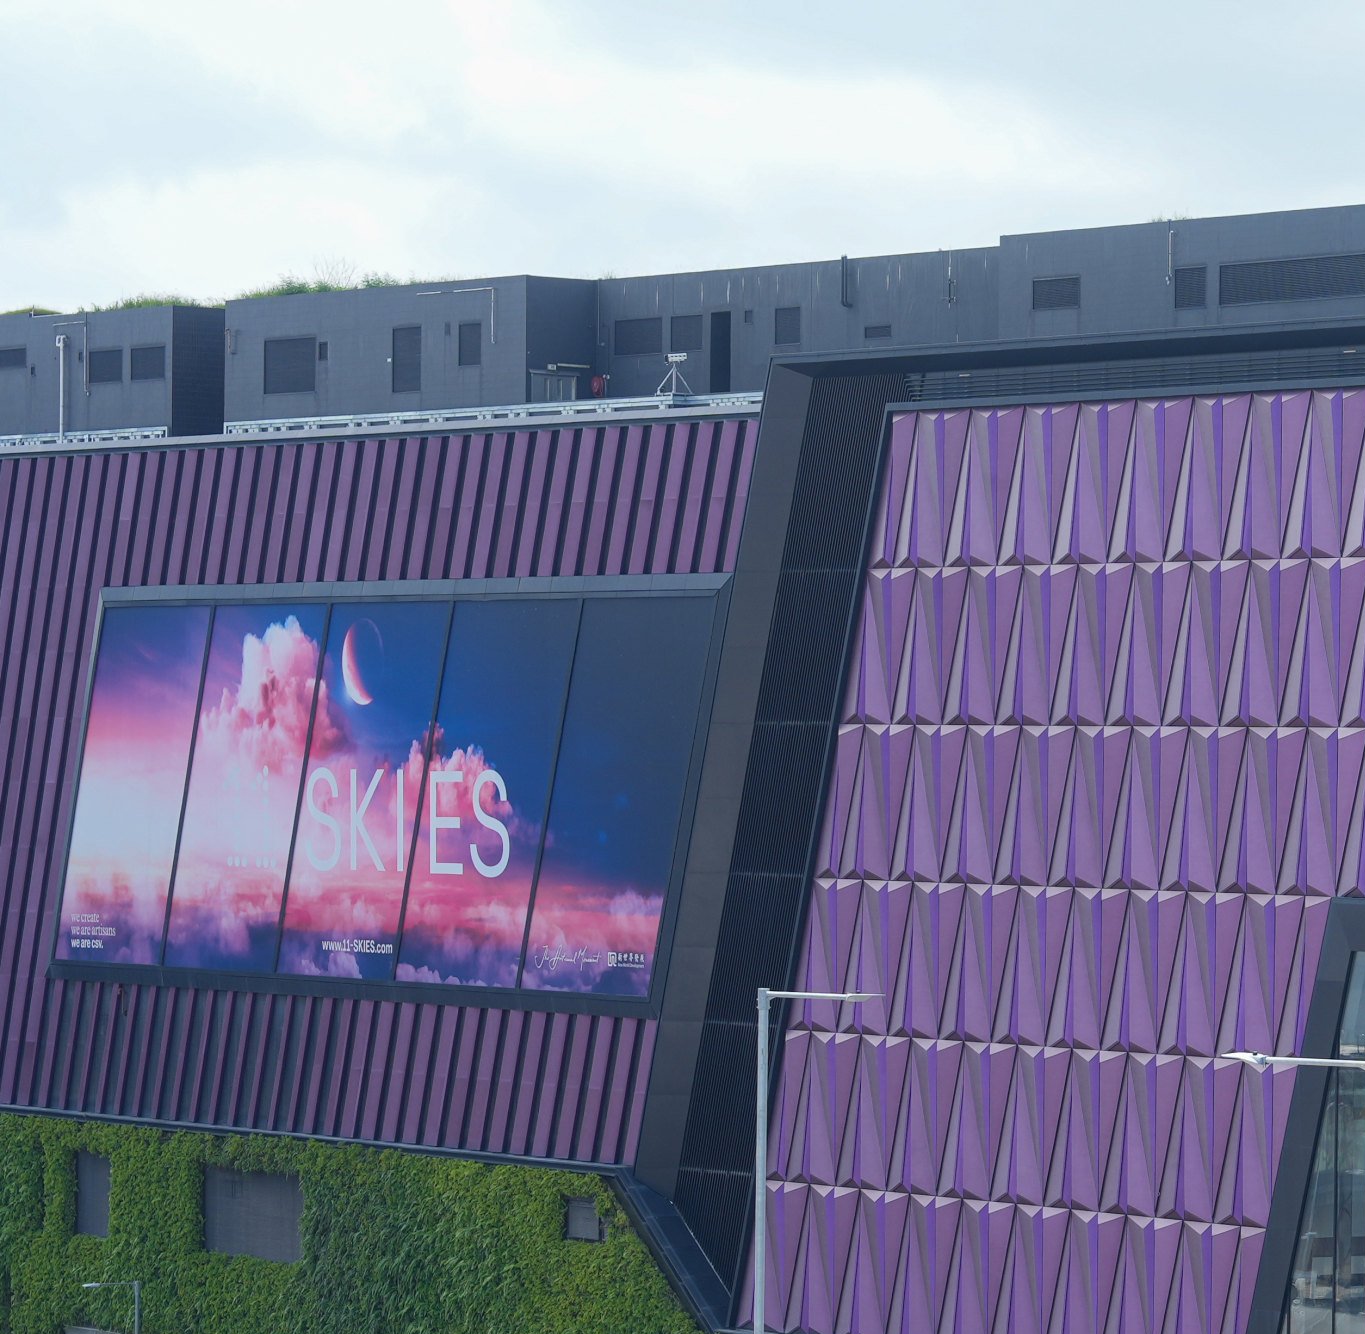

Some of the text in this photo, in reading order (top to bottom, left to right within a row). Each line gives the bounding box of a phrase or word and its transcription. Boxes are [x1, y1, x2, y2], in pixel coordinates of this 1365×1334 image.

[306, 766, 510, 878] SKIES
[71, 912, 100, 922] we create
[71, 924, 116, 936] we are artisans
[71, 939, 104, 949] we are csv.
[322, 939, 393, 954] www.11-SKIES.com
